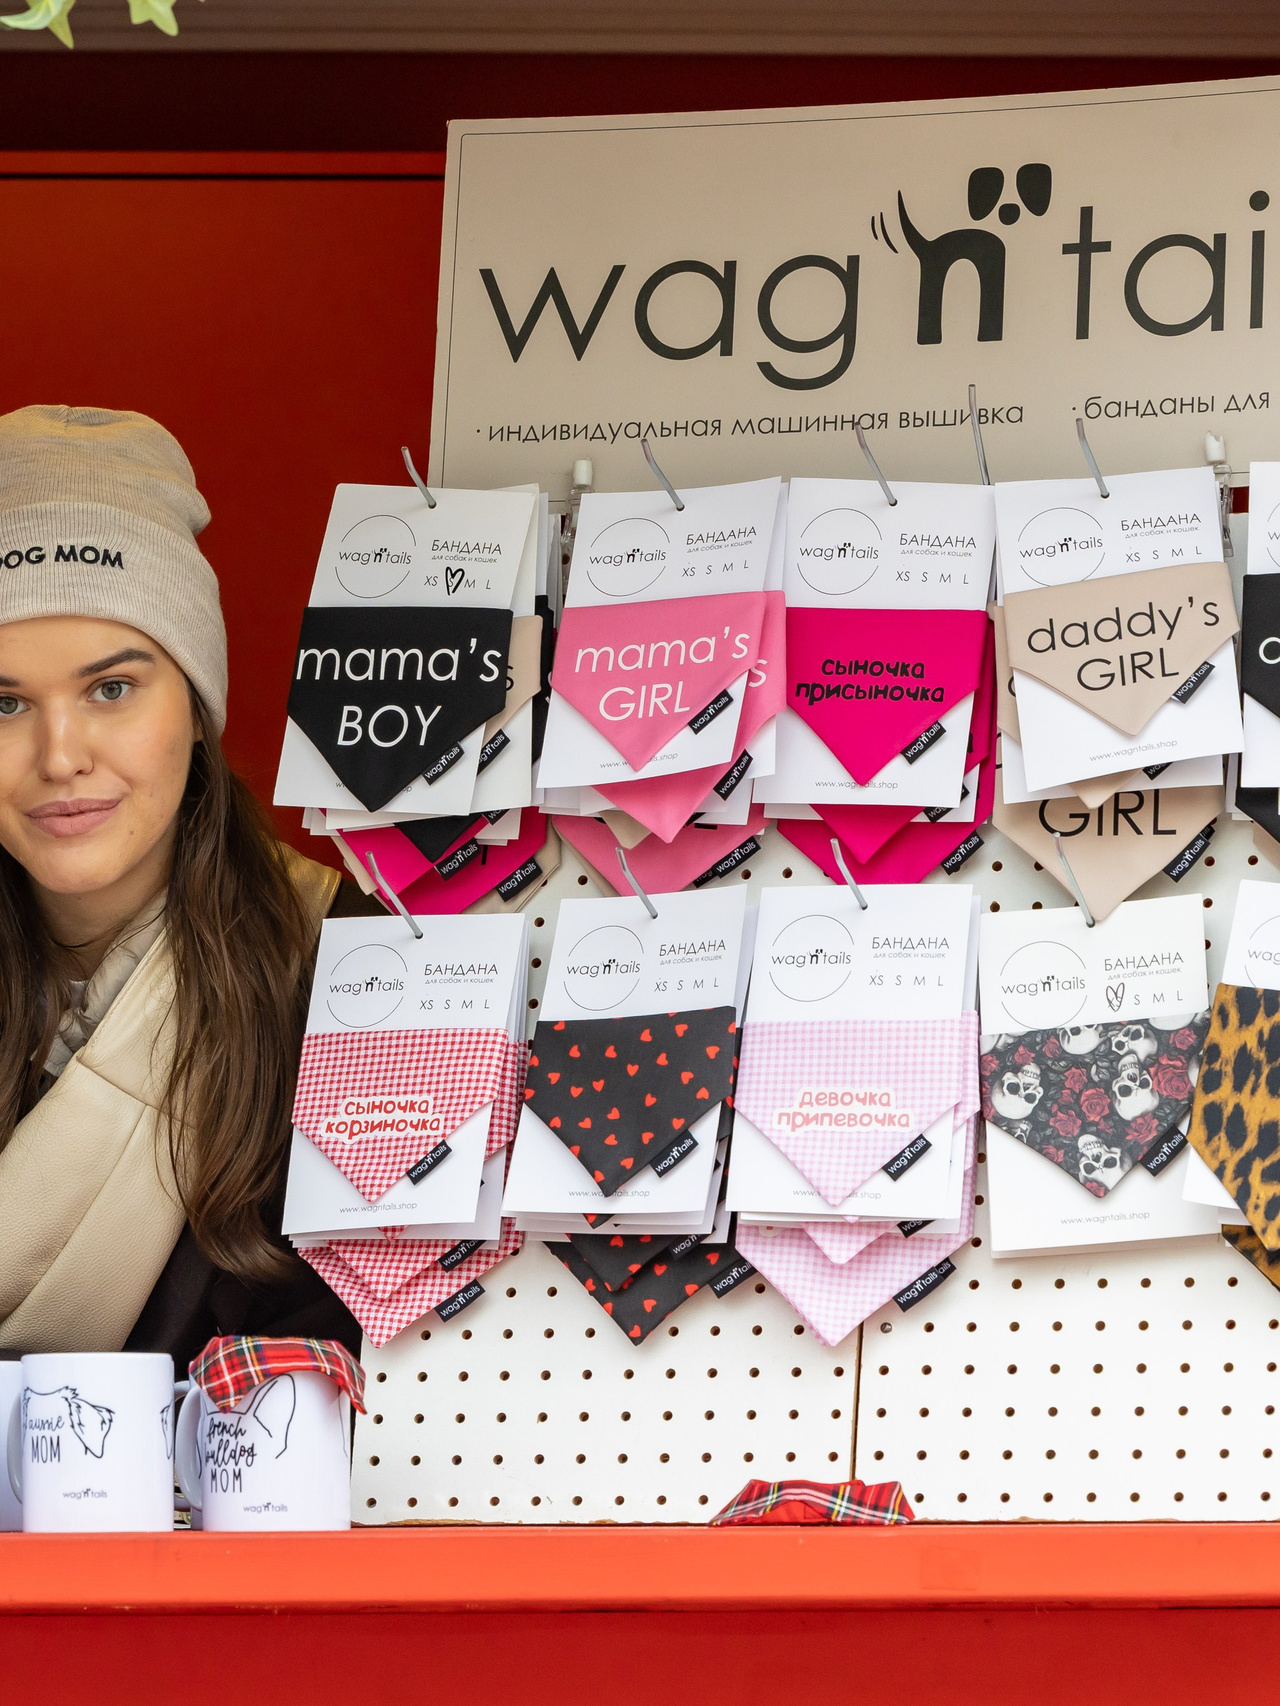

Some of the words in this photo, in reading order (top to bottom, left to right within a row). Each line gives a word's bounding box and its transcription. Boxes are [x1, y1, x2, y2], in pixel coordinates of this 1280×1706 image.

[488, 418, 722, 444] индивидуальная
[731, 412, 888, 436] машинная
[898, 403, 1024, 429] вышивка
[1084, 395, 1215, 420] банданы
[1223, 391, 1271, 414] для
[1120, 513, 1201, 532] БАНДАНА
[686, 526, 757, 545] БАНДАНА
[899, 533, 977, 549] БАНДАНА
[1140, 529, 1165, 537] собак
[431, 539, 502, 555] БАНДАНА
[700, 543, 723, 552] собак
[730, 540, 753, 548] кошек
[1125, 552, 1141, 563] XS
[1152, 550, 1159, 560] S
[1171, 548, 1184, 557] M
[1195, 546, 1202, 555] L
[54, 545, 124, 570] MOM
[681, 566, 696, 578] XS
[705, 565, 713, 575] S
[722, 562, 734, 572] M
[743, 560, 749, 569] L
[895, 571, 910, 582] XS
[921, 571, 928, 582] S
[939, 573, 951, 583] M
[963, 574, 969, 584] L
[424, 575, 439, 587] XS
[485, 580, 491, 589] L
[1027, 596, 1220, 654] daddy's
[574, 626, 751, 673] mama's
[295, 638, 502, 682] mama's
[821, 659, 925, 679] сыночка
[1076, 647, 1180, 691] GIRL
[599, 681, 691, 721] GIRL
[795, 682, 945, 706] присыночка
[337, 704, 442, 748] BOY
[1089, 739, 1178, 762] www.wagntails.shop
[1038, 789, 1177, 837] GIRL
[659, 939, 727, 957] БАНДАНА
[871, 936, 950, 951] БАНДАНА
[672, 956, 694, 965] собак
[701, 954, 723, 962] кошек
[1104, 952, 1184, 972] БАНДАНА
[424, 963, 499, 976] БАНДАНА
[654, 981, 668, 992] XS
[677, 980, 684, 991] S
[692, 979, 704, 989] M
[713, 977, 719, 987] L
[869, 975, 884, 986] XS
[895, 975, 902, 986] S
[913, 976, 926, 986] M
[937, 976, 943, 986] L
[419, 1000, 434, 1010] XS
[444, 999, 451, 1010] S
[461, 999, 473, 1009] M
[484, 999, 490, 1009] L
[1134, 994, 1141, 1005] S
[1153, 993, 1165, 1003] M
[1177, 990, 1183, 1001] L
[344, 1099, 430, 1116] сыночка
[799, 1091, 891, 1108] девочка
[325, 1117, 441, 1140] корзиночка
[777, 1111, 910, 1132] припевочка
[339, 1202, 417, 1213] www.wagntails.shop
[1060, 1211, 1150, 1224] www.wagntails.shop
[29, 1415, 65, 1431] aussie
[207, 1416, 246, 1444] french
[31, 1435, 60, 1463] MOM
[210, 1468, 242, 1493] MOM
